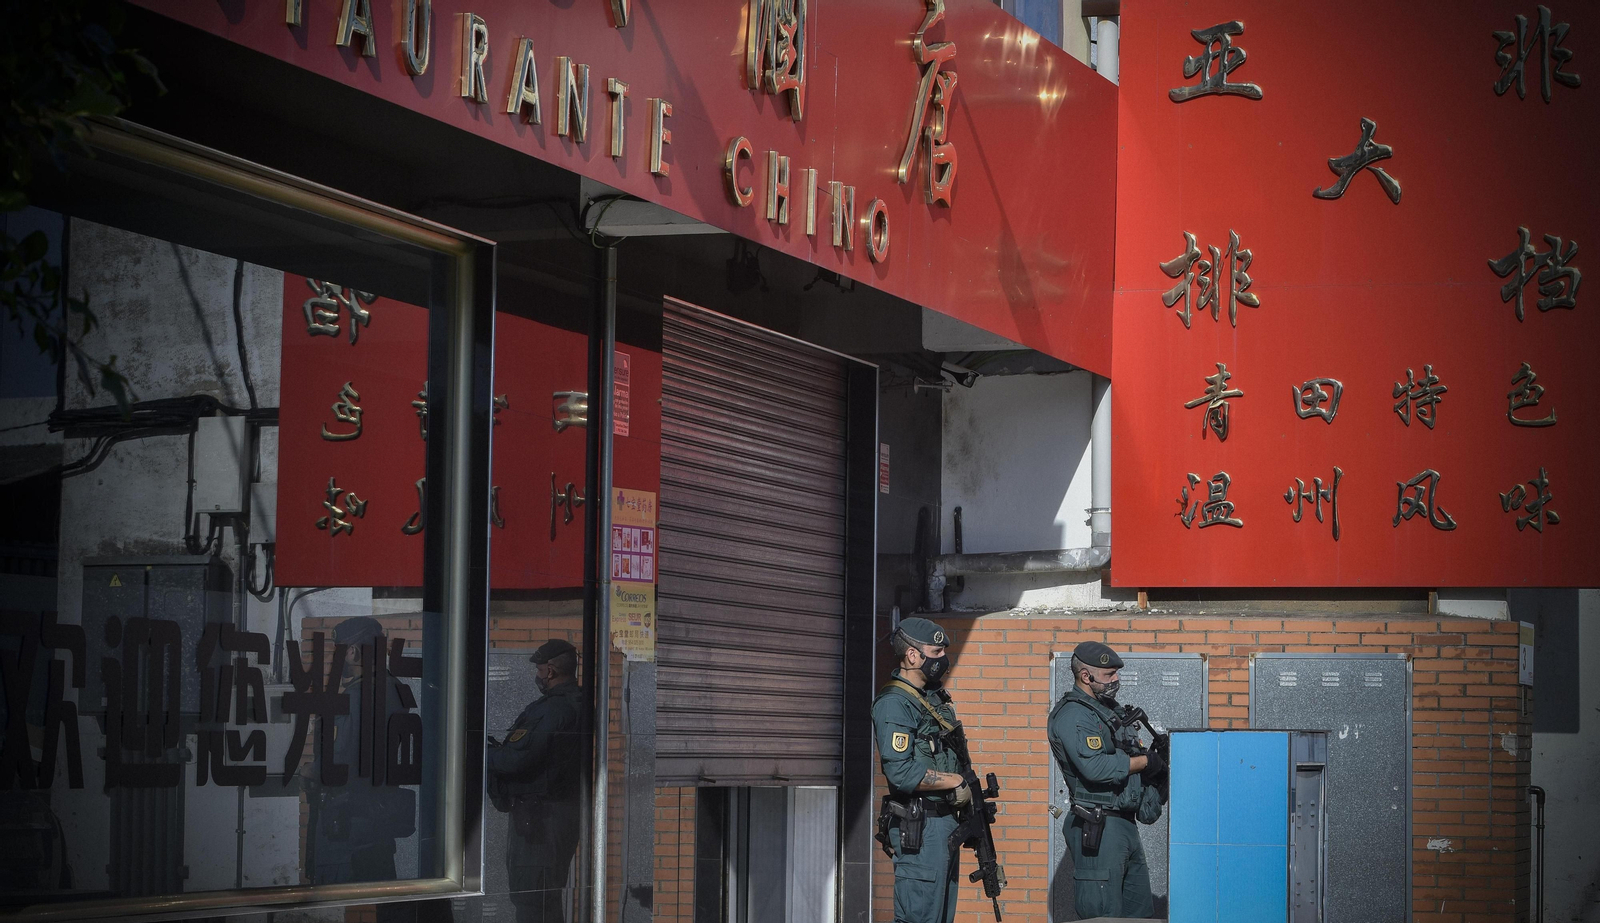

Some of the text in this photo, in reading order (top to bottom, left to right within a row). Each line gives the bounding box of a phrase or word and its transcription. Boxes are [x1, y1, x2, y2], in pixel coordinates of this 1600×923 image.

[1312, 117, 1402, 204] 大
[726, 136, 890, 263] CHINO
[1184, 362, 1557, 441] 青田特色
[1174, 466, 1561, 541] 温州风味
[621, 591, 647, 603] CORREOS
[628, 612, 642, 621] SEUR
